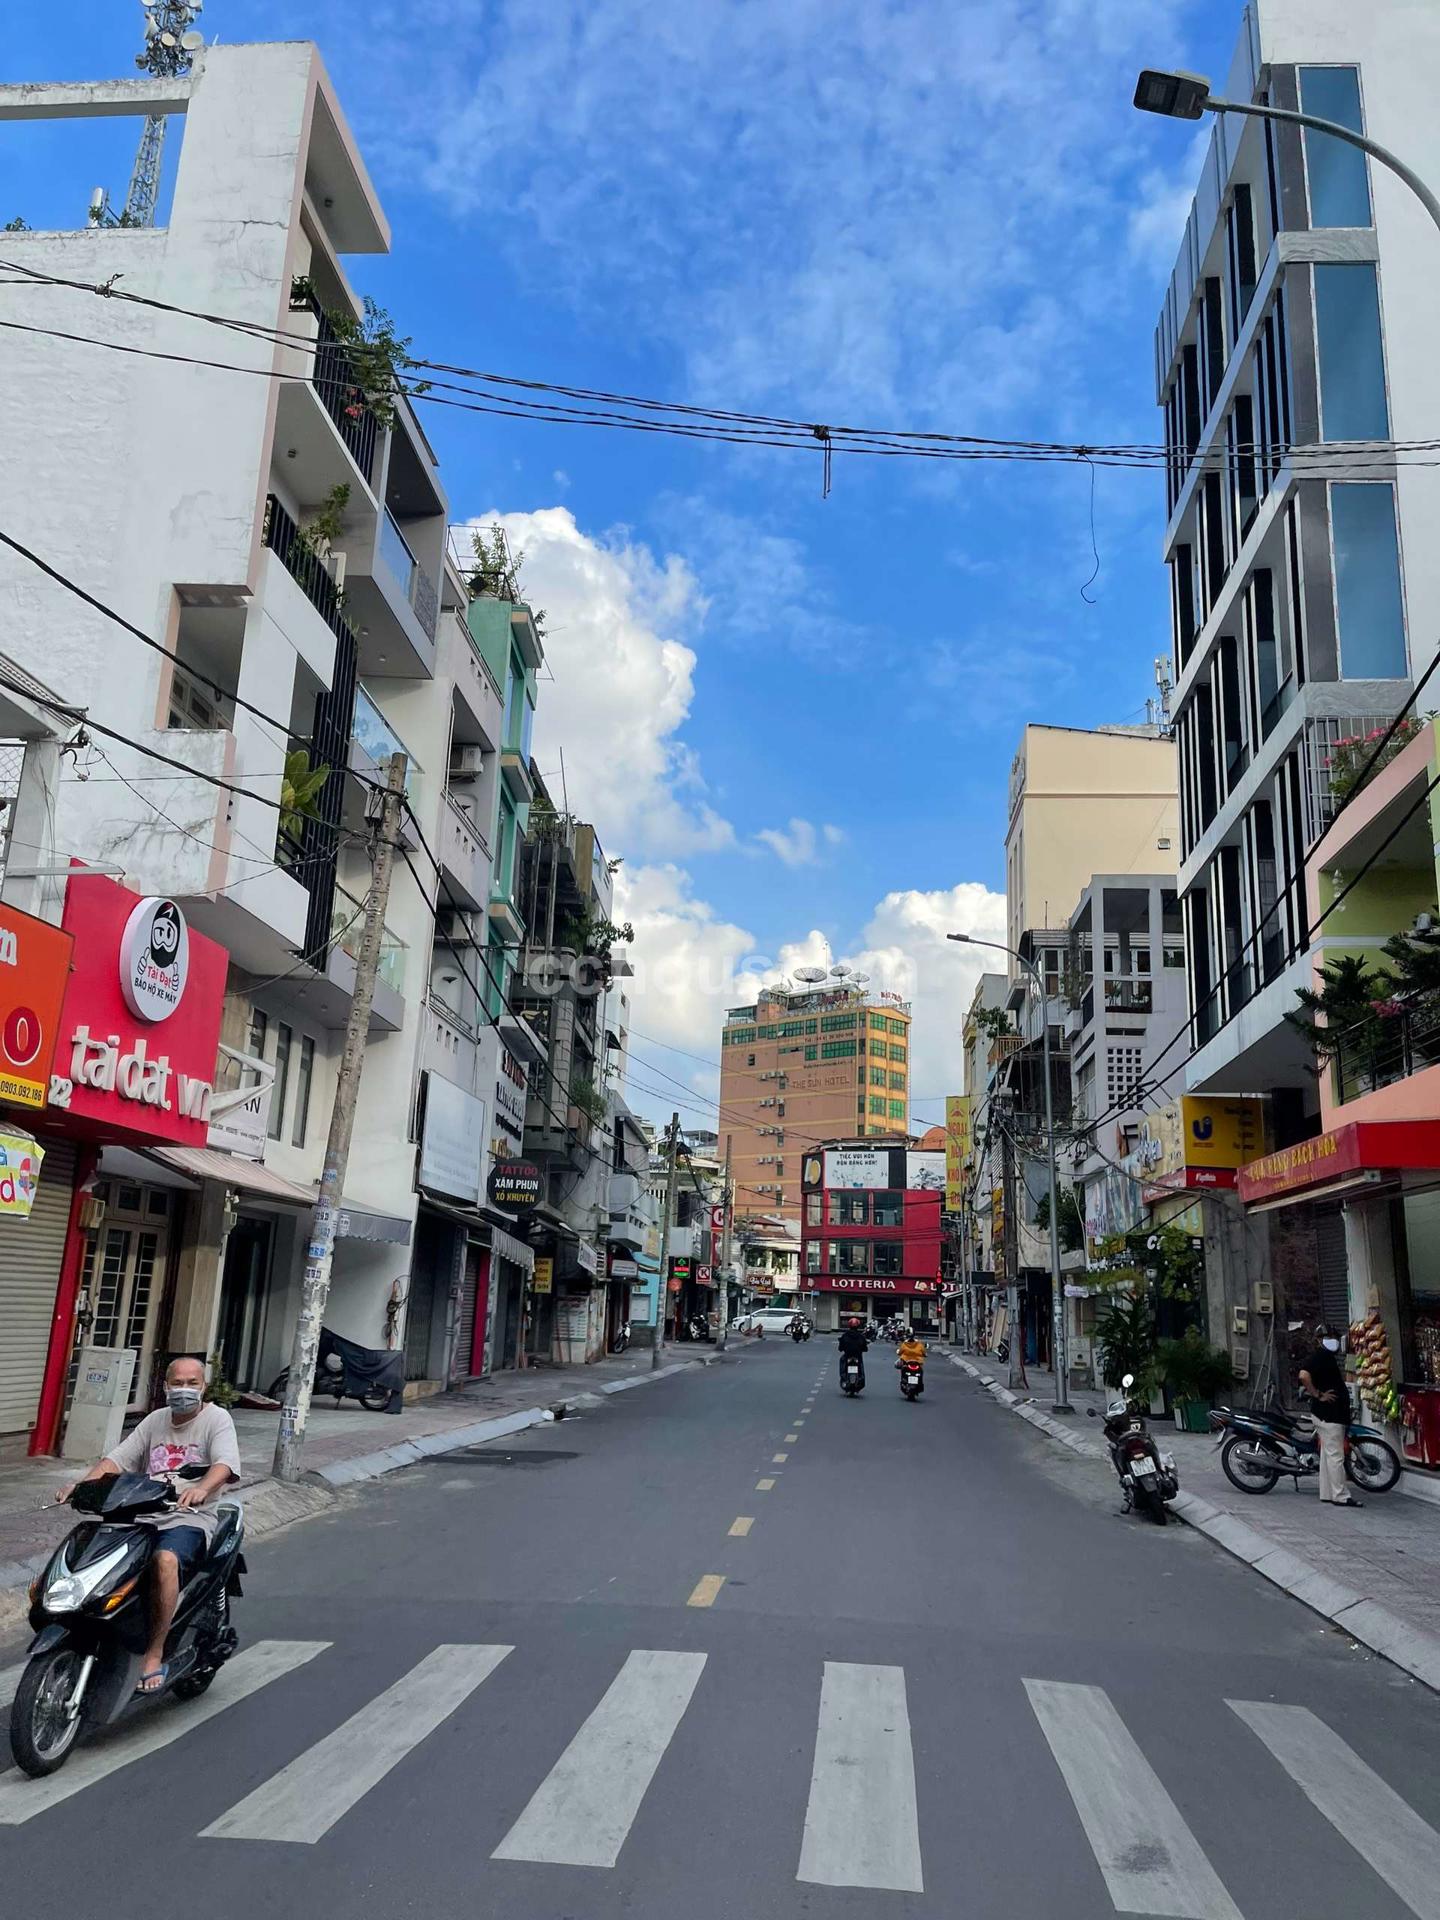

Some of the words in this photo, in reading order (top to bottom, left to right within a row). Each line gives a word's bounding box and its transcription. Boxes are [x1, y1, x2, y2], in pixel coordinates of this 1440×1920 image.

[157, 988, 165, 999] XE
[498, 1165, 538, 1176] TATTOO
[516, 1180, 539, 1190] PHUN
[832, 1279, 896, 1289] LOTTERIA
